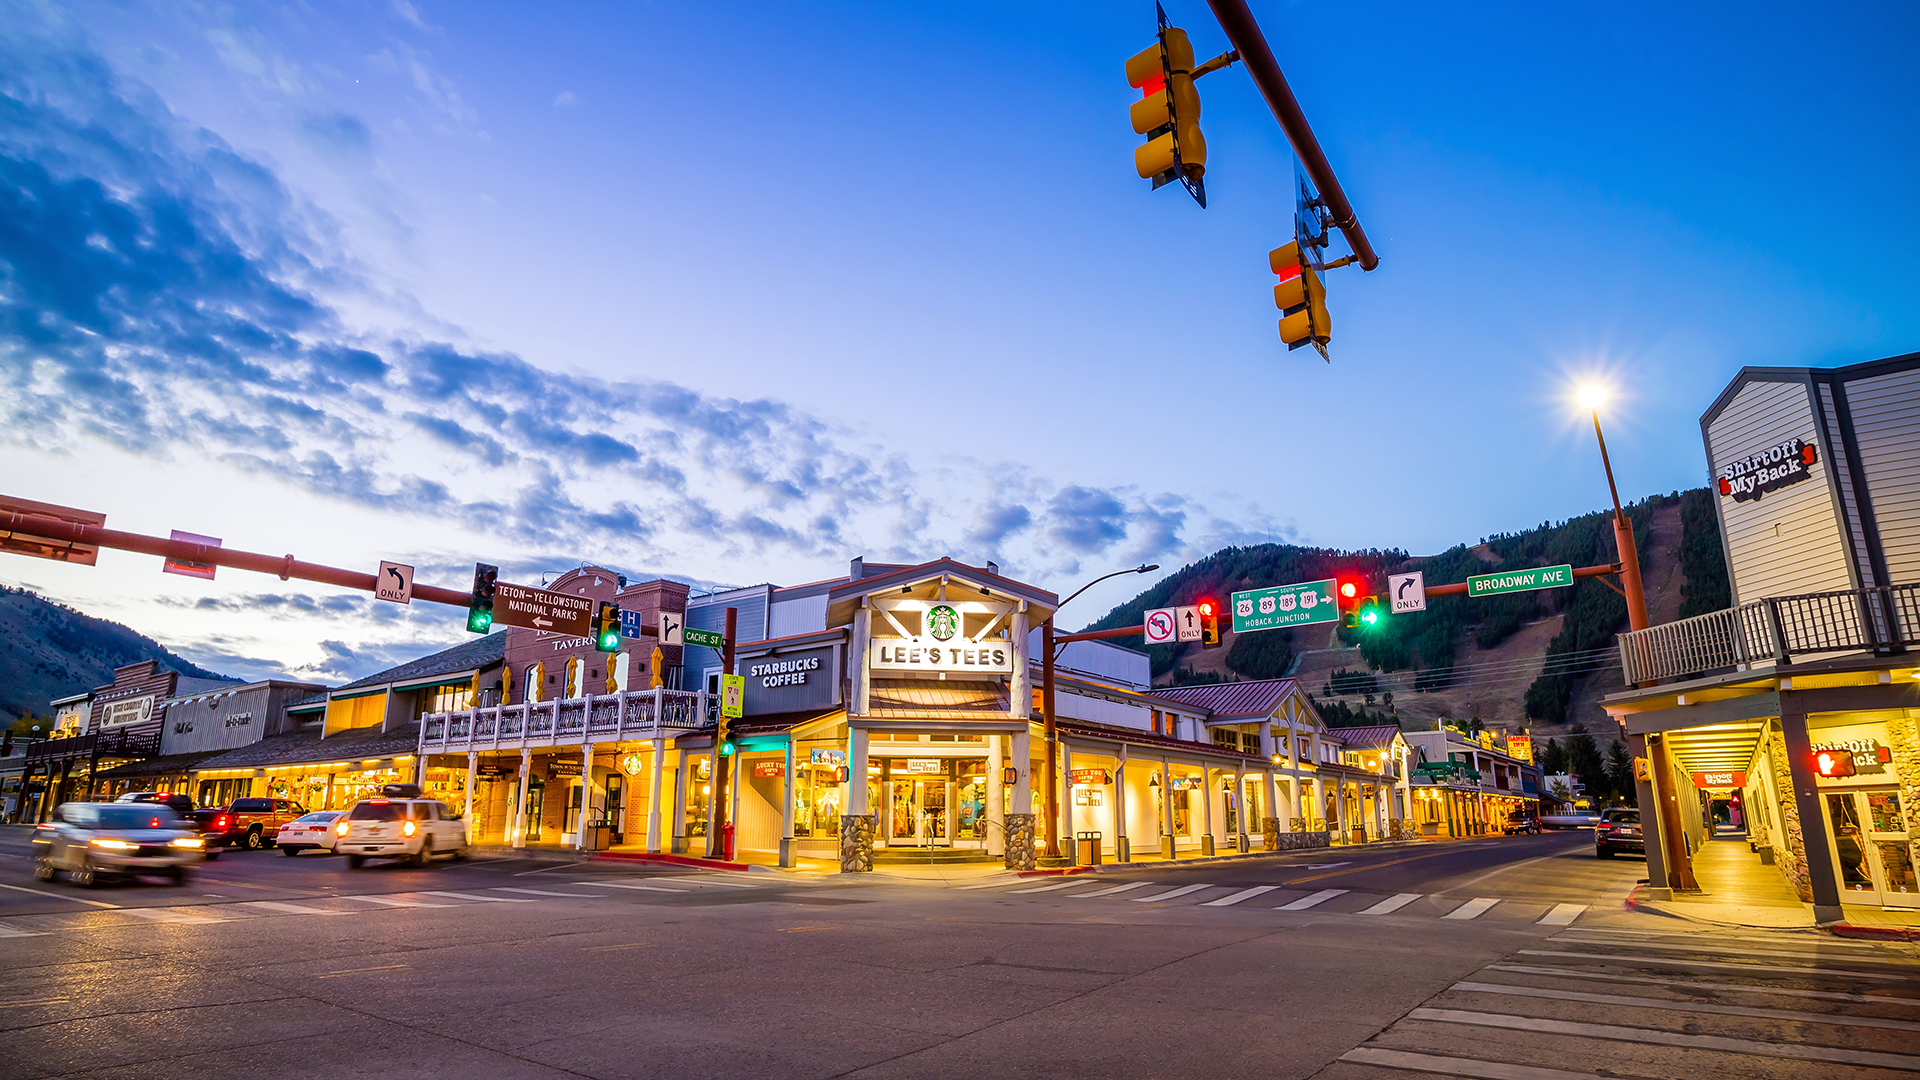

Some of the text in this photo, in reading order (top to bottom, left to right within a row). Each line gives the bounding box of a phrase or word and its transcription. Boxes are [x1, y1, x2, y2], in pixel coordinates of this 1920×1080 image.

[1724, 438, 1798, 481] ShirtOff
[1728, 458, 1802, 495] MyBack
[1475, 570, 1564, 591] BROADWAY AVE
[380, 589, 405, 600] ONLY
[508, 600, 578, 621] NATIONAL PARKS
[1240, 594, 1314, 613] 26 89 189 191
[1396, 600, 1420, 610] ONLY
[627, 612, 636, 624] H
[1245, 612, 1311, 627] HOBACK JUNCTION
[686, 631, 719, 645] CACHE ST
[1181, 629, 1200, 638] ONLY
[880, 646, 1005, 666] LEE'S TEES
[751, 657, 819, 677] STARBUCKS
[762, 672, 805, 688] COFFEE
[756, 761, 774, 769] LUCKY
